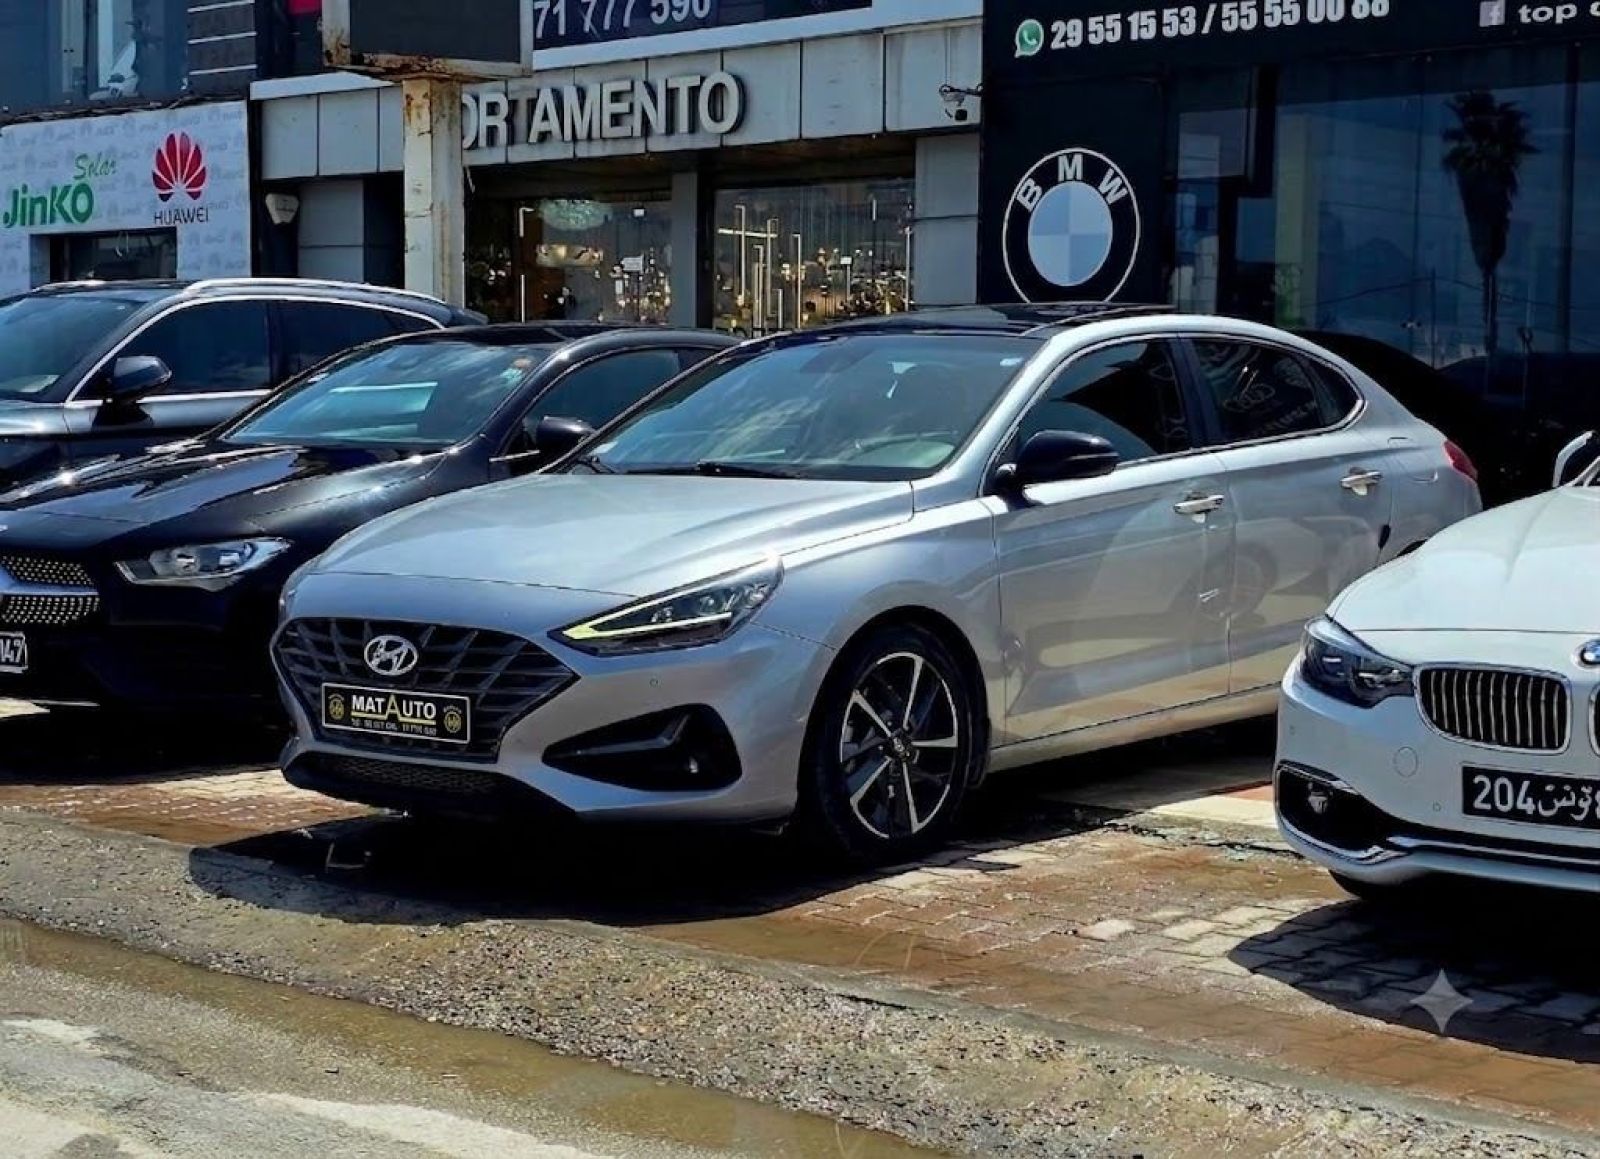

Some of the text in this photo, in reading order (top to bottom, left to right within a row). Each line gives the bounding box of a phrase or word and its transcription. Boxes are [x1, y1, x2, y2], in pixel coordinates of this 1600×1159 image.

[533, 0, 566, 39] 71
[1051, 18, 1083, 50] 29
[1088, 13, 1122, 45] 55
[1128, 10, 1157, 41] 15
[1162, 6, 1197, 37] 53
[1201, 3, 1217, 34] /
[1221, 1, 1257, 32] 55
[1264, 0, 1300, 28] 55
[1518, 3, 1578, 24] top
[1016, 153, 1128, 213] BMW
[154, 207, 209, 226] HUAWEI
[1473, 774, 1537, 815] 204
